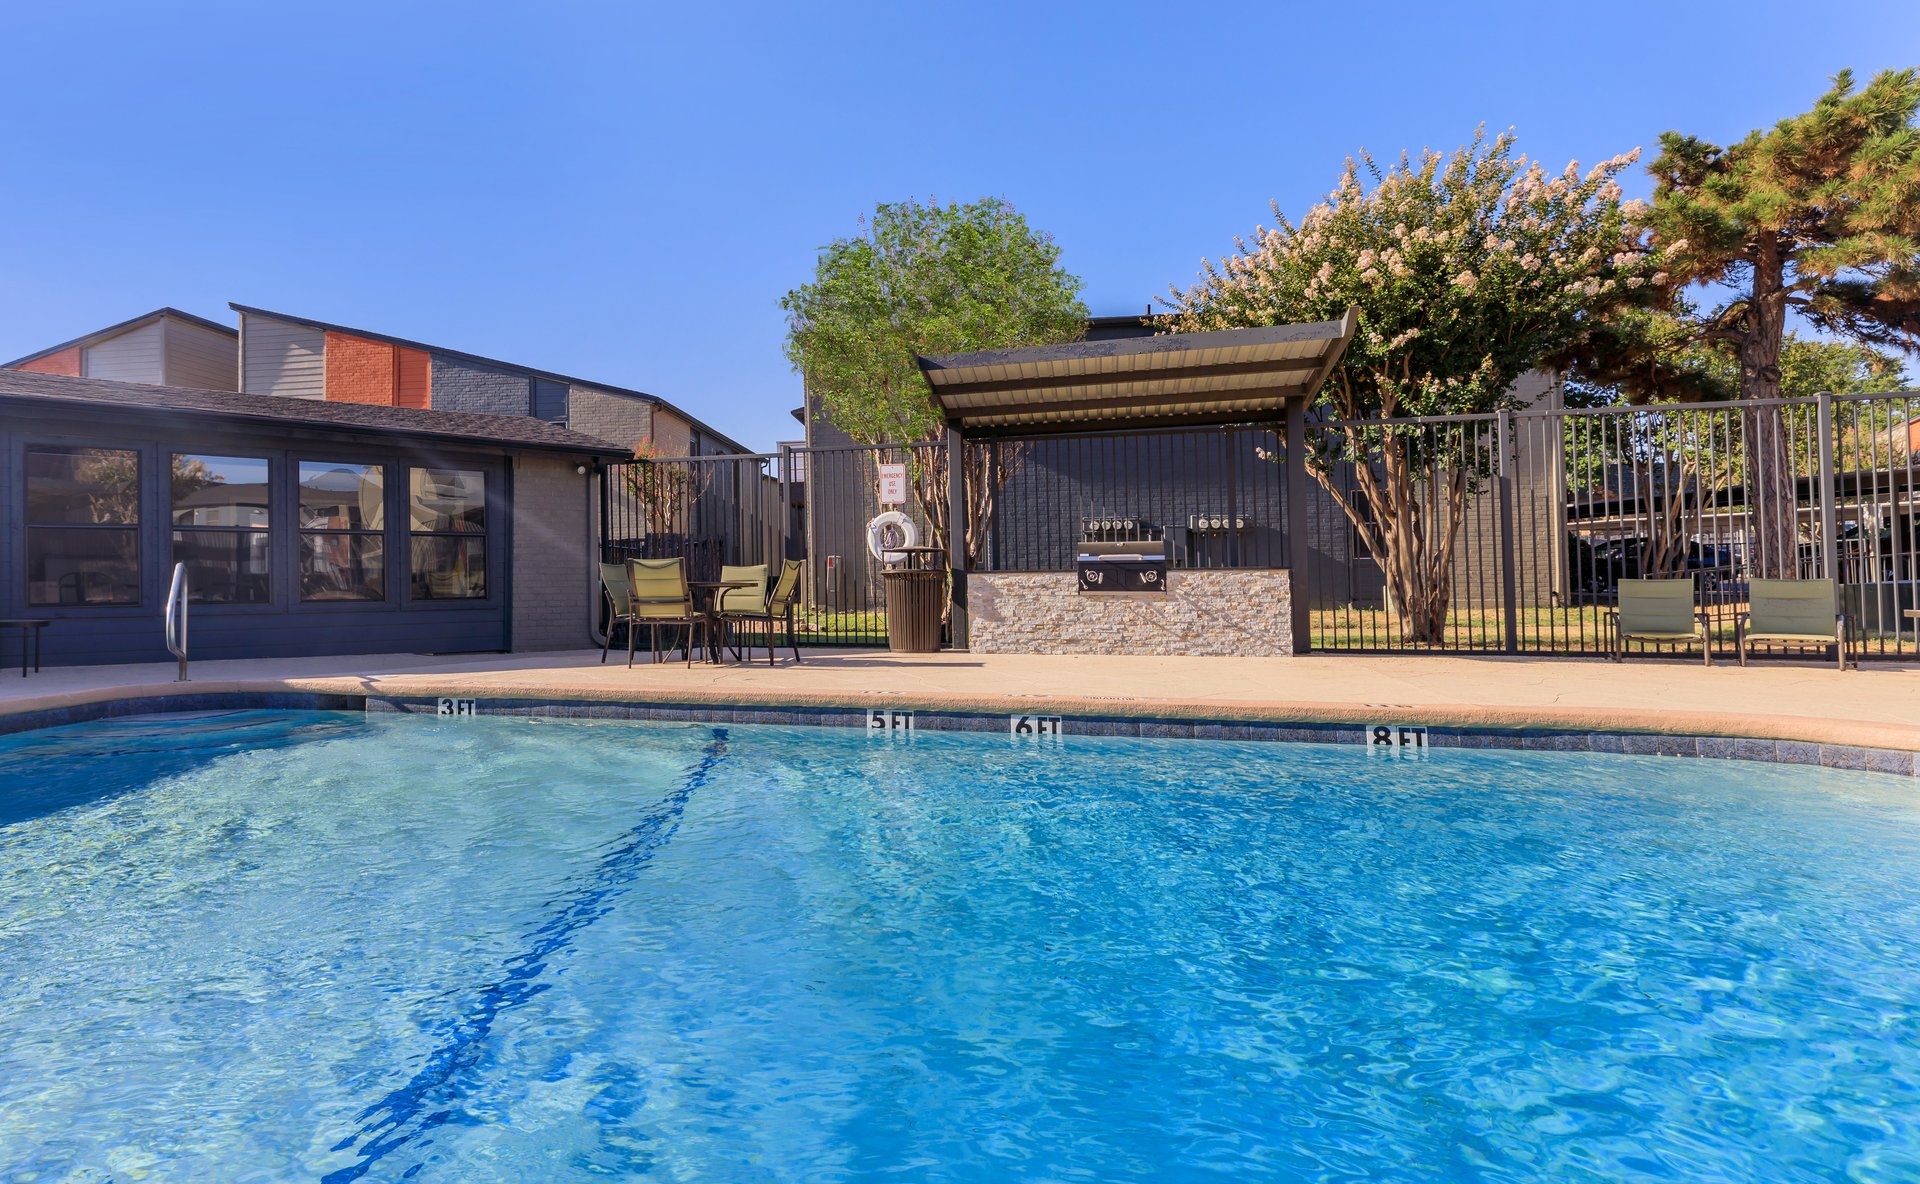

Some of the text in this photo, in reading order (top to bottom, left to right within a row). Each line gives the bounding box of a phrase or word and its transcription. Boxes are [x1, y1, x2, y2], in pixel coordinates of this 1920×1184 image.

[441, 699, 475, 715] 3 FT
[872, 710, 913, 729] 5 FT
[1015, 716, 1061, 734] 6 FT
[1373, 726, 1426, 747] 8 FT
